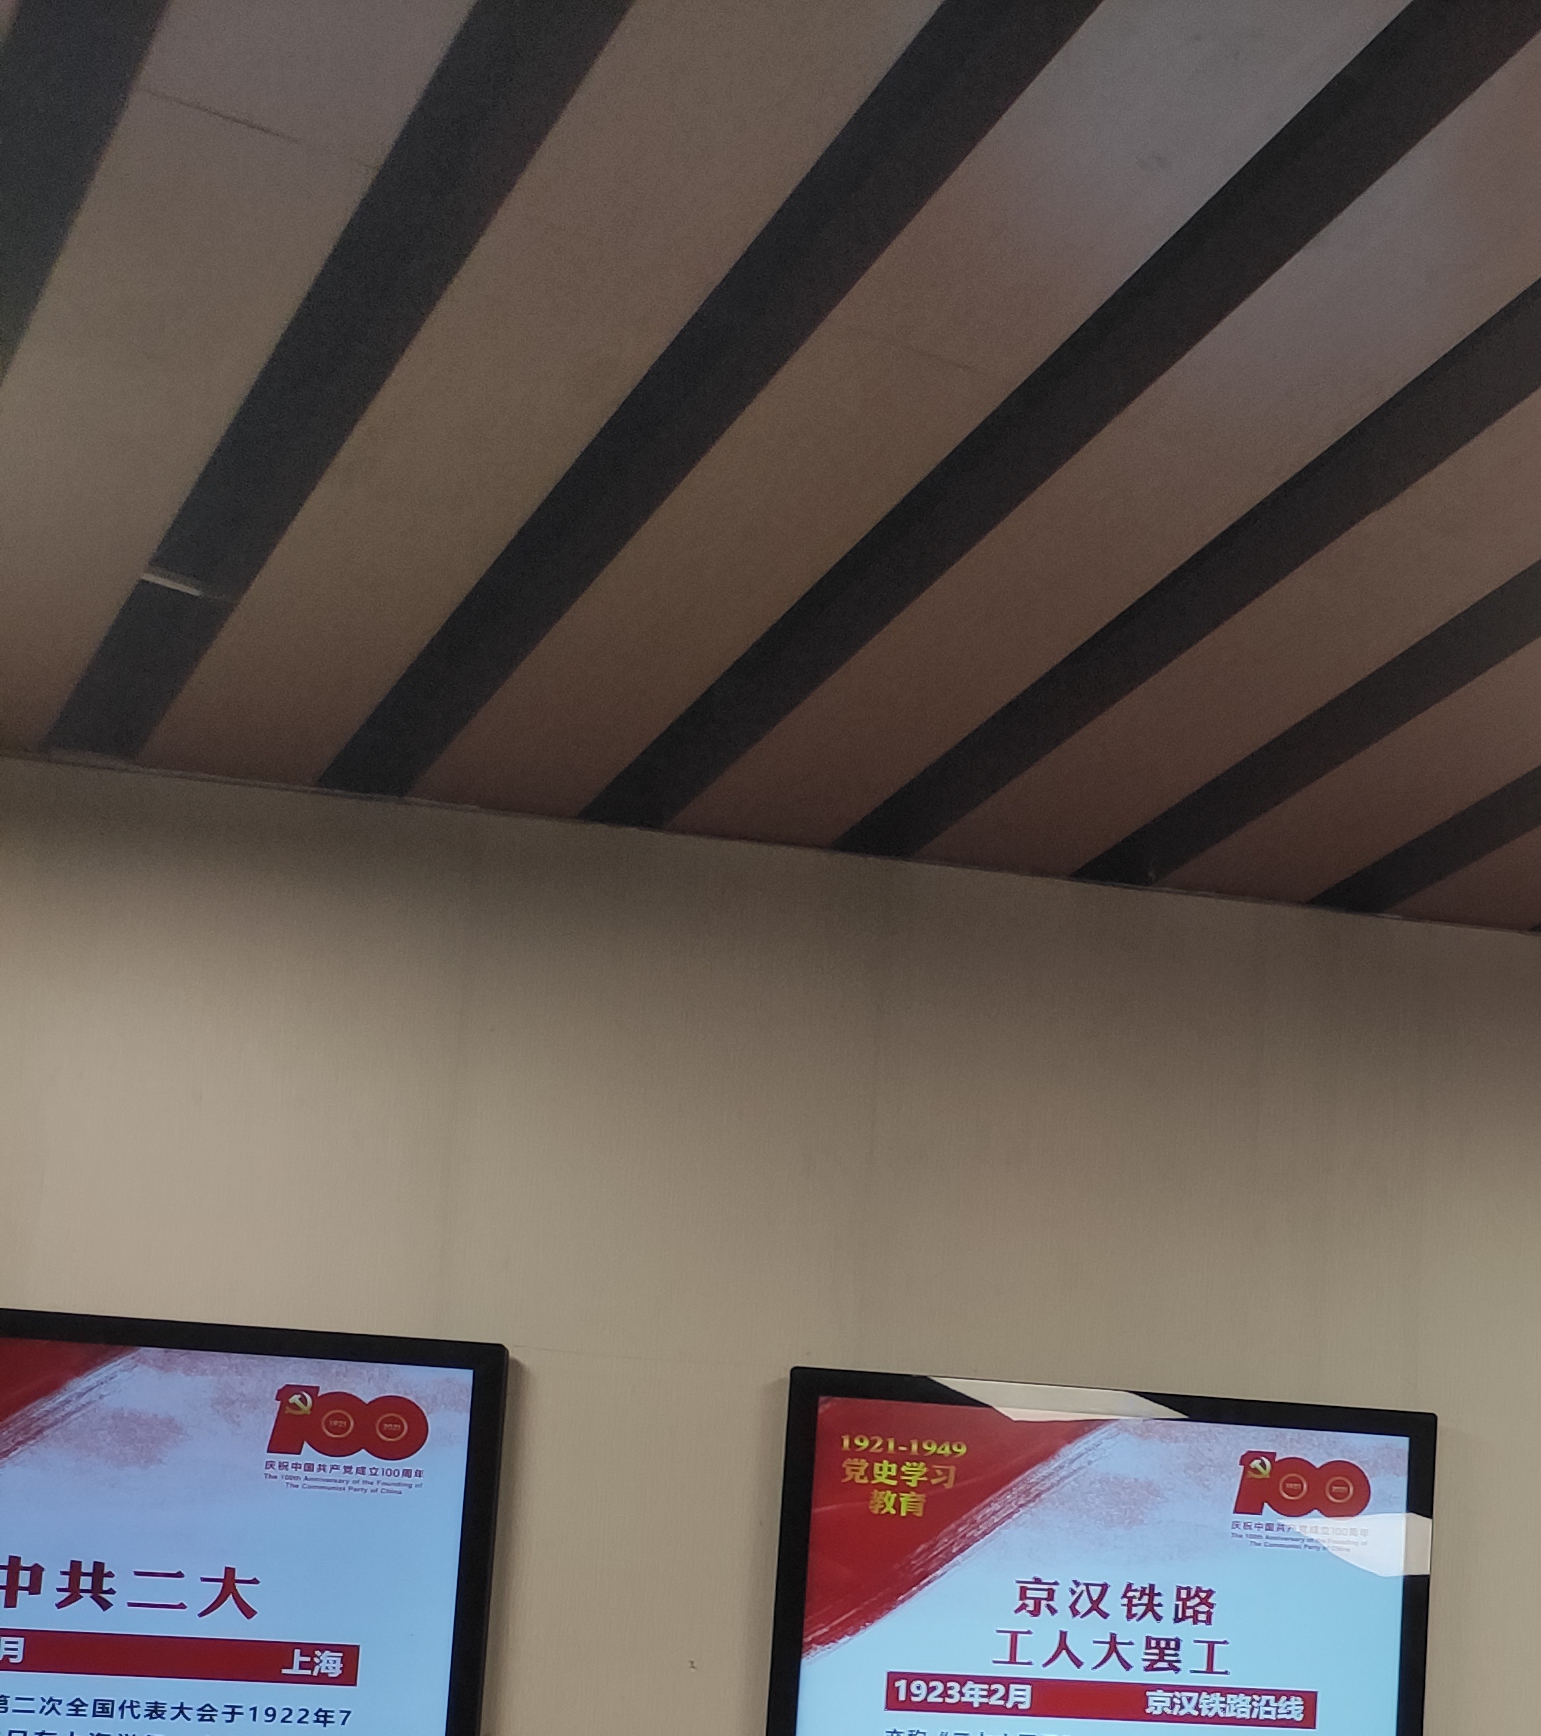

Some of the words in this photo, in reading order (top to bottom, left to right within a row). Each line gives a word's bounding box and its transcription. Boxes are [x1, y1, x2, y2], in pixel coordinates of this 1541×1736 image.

[266, 1384, 429, 1461] 100
[840, 1433, 967, 1459] 1921-1949
[264, 1460, 424, 1479] 庆祝中国共产党成立100周年
[841, 1458, 957, 1489] 党史学习
[1233, 1450, 1371, 1517] 100
[868, 1489, 927, 1518] 教育
[0, 1555, 260, 1620] 中共二大
[1014, 1577, 1218, 1626] 京汉铁路
[281, 1648, 344, 1678] 上海
[992, 1629, 1231, 1676] 工人大罢工
[894, 1679, 1032, 1710] 1923年2月
[1145, 1690, 1305, 1722] 京汉铁路沿线
